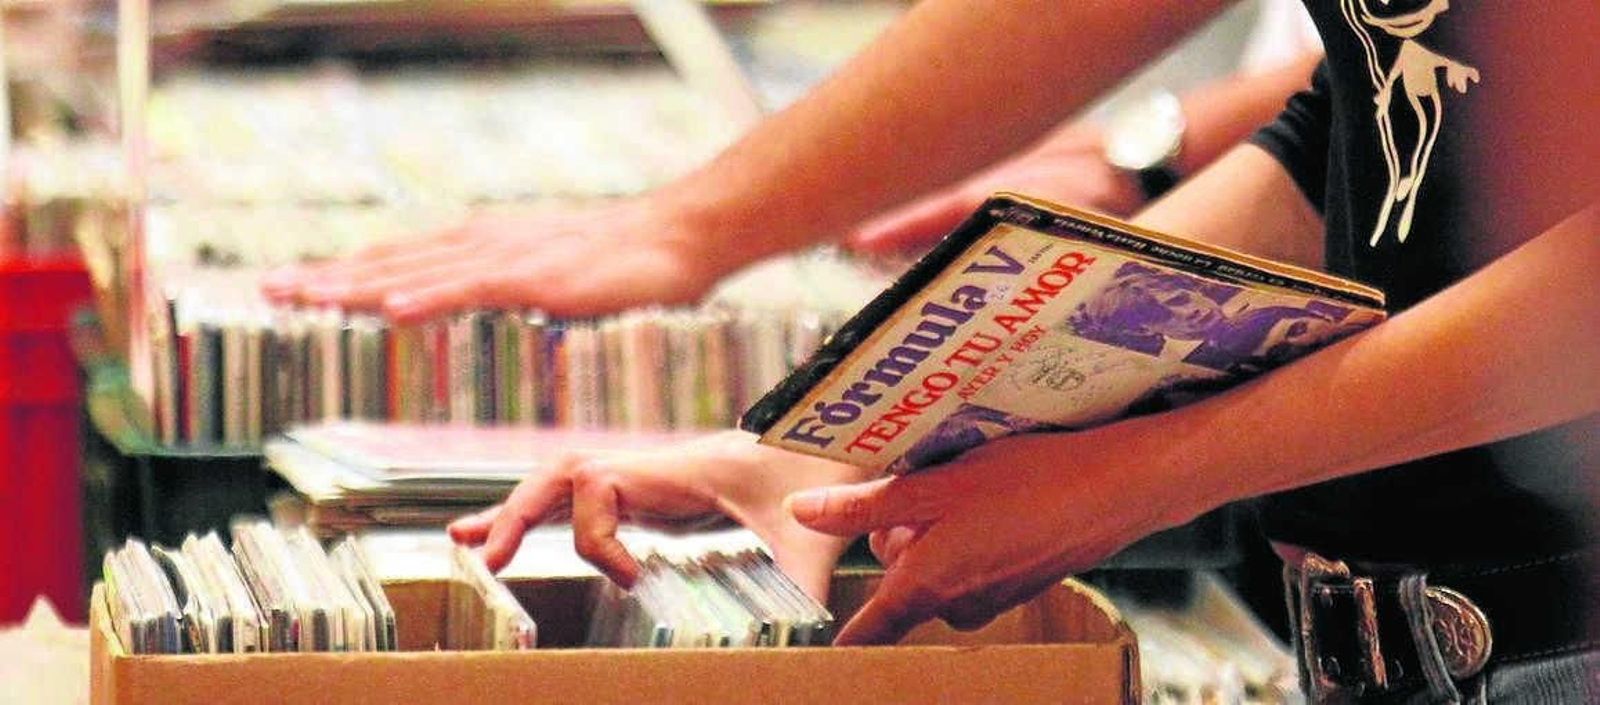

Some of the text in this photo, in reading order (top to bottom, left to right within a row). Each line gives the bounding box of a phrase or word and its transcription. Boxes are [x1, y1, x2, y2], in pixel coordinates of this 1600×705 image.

[780, 285, 988, 449] Fórmula
[962, 245, 1025, 275] V
[843, 251, 1097, 455] TENGO TU AMOR
[957, 366, 1000, 401] AYER
[997, 352, 1014, 364] Y
[1011, 325, 1047, 354] HOY
